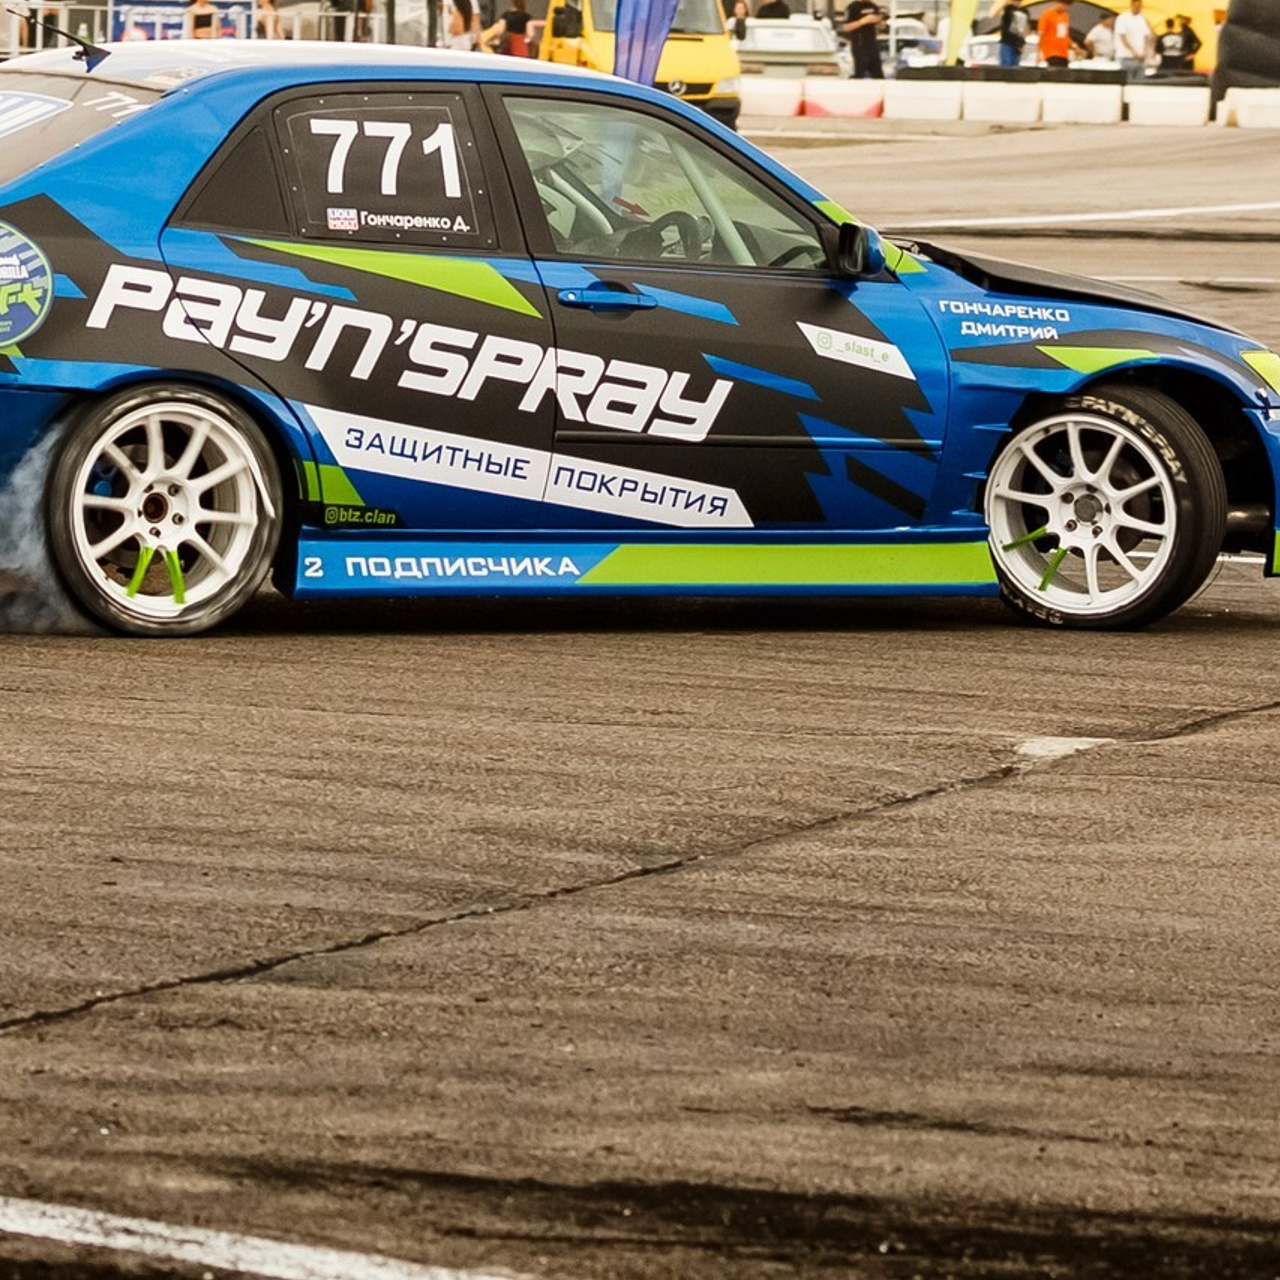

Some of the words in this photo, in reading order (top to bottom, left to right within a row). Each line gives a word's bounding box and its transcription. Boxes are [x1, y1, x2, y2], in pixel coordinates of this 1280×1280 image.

[310, 118, 462, 199] 771
[360, 211, 451, 230] Гончаренко
[939, 300, 1070, 322] ГОНЧАРЕНКО
[960, 321, 1059, 340] ДМИТРИЙ
[345, 427, 531, 480] ЗАЩИТНЫЕ
[553, 466, 729, 517] ПОКРЫТИЯ
[304, 557, 324, 578] 2
[345, 556, 582, 579] ПОДПИСЧИКА
